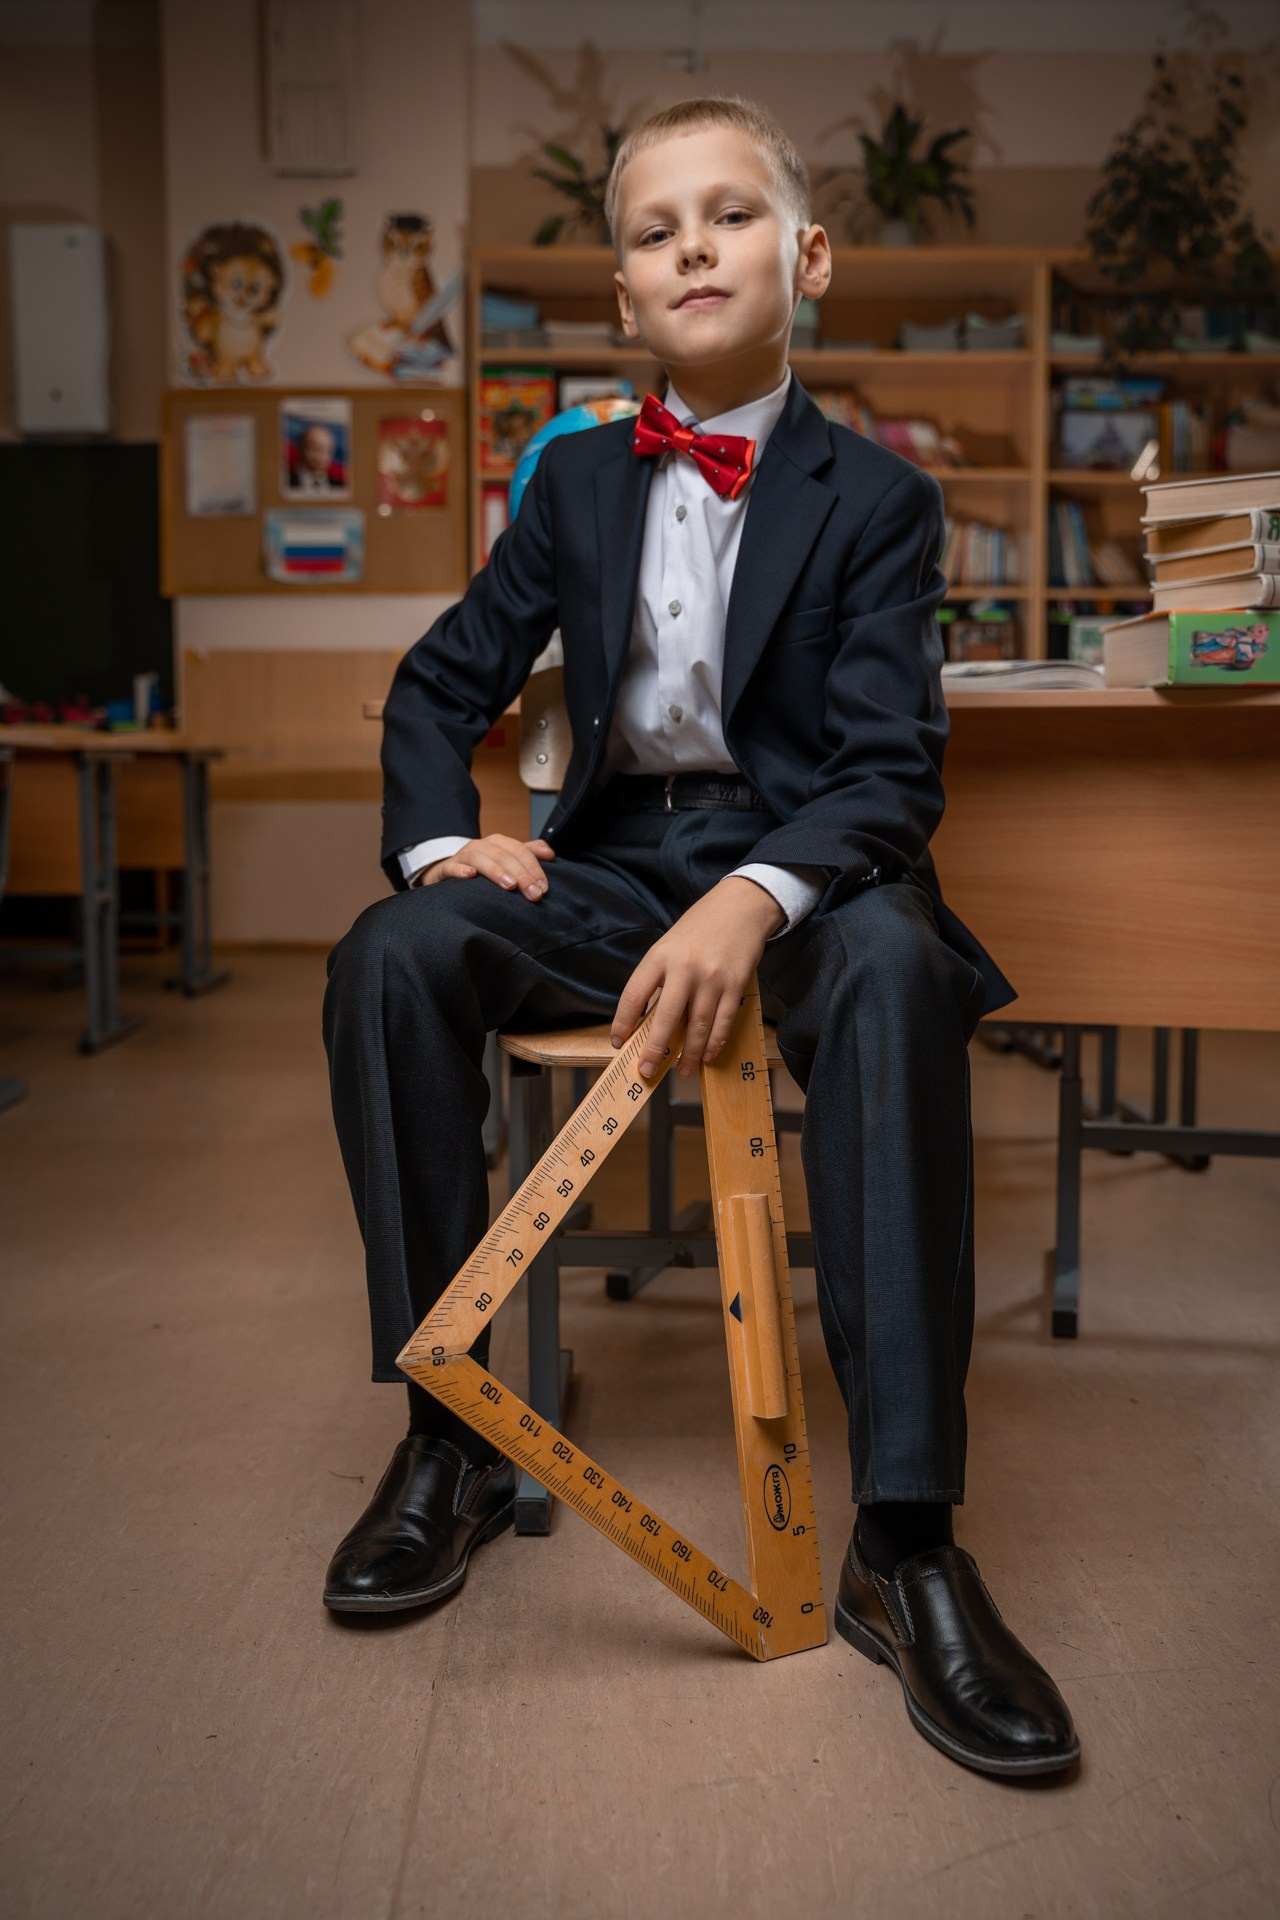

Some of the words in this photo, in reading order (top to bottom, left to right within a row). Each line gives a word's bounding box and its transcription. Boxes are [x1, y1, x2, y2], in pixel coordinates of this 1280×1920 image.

[627, 1082, 643, 1102] 20
[602, 1116, 619, 1136] 30
[580, 1148, 596, 1167] 40
[556, 1178, 574, 1198] 50
[532, 1211, 550, 1231] 60
[505, 1248, 524, 1268] 70
[474, 1292, 493, 1312] 80
[740, 1061, 755, 1081] 35
[750, 1137, 764, 1157] 30
[783, 1443, 797, 1464] 10
[792, 1525, 806, 1537] 5
[801, 1602, 814, 1615] 0
[431, 1346, 446, 1366] 90
[479, 1381, 504, 1405] 100
[519, 1414, 542, 1438] 110
[552, 1441, 575, 1465] 120
[583, 1466, 606, 1490] 130
[611, 1490, 634, 1514] 140
[640, 1514, 662, 1538] 150
[671, 1540, 693, 1563] 160
[707, 1570, 729, 1593] 170
[752, 1606, 774, 1629] 180
